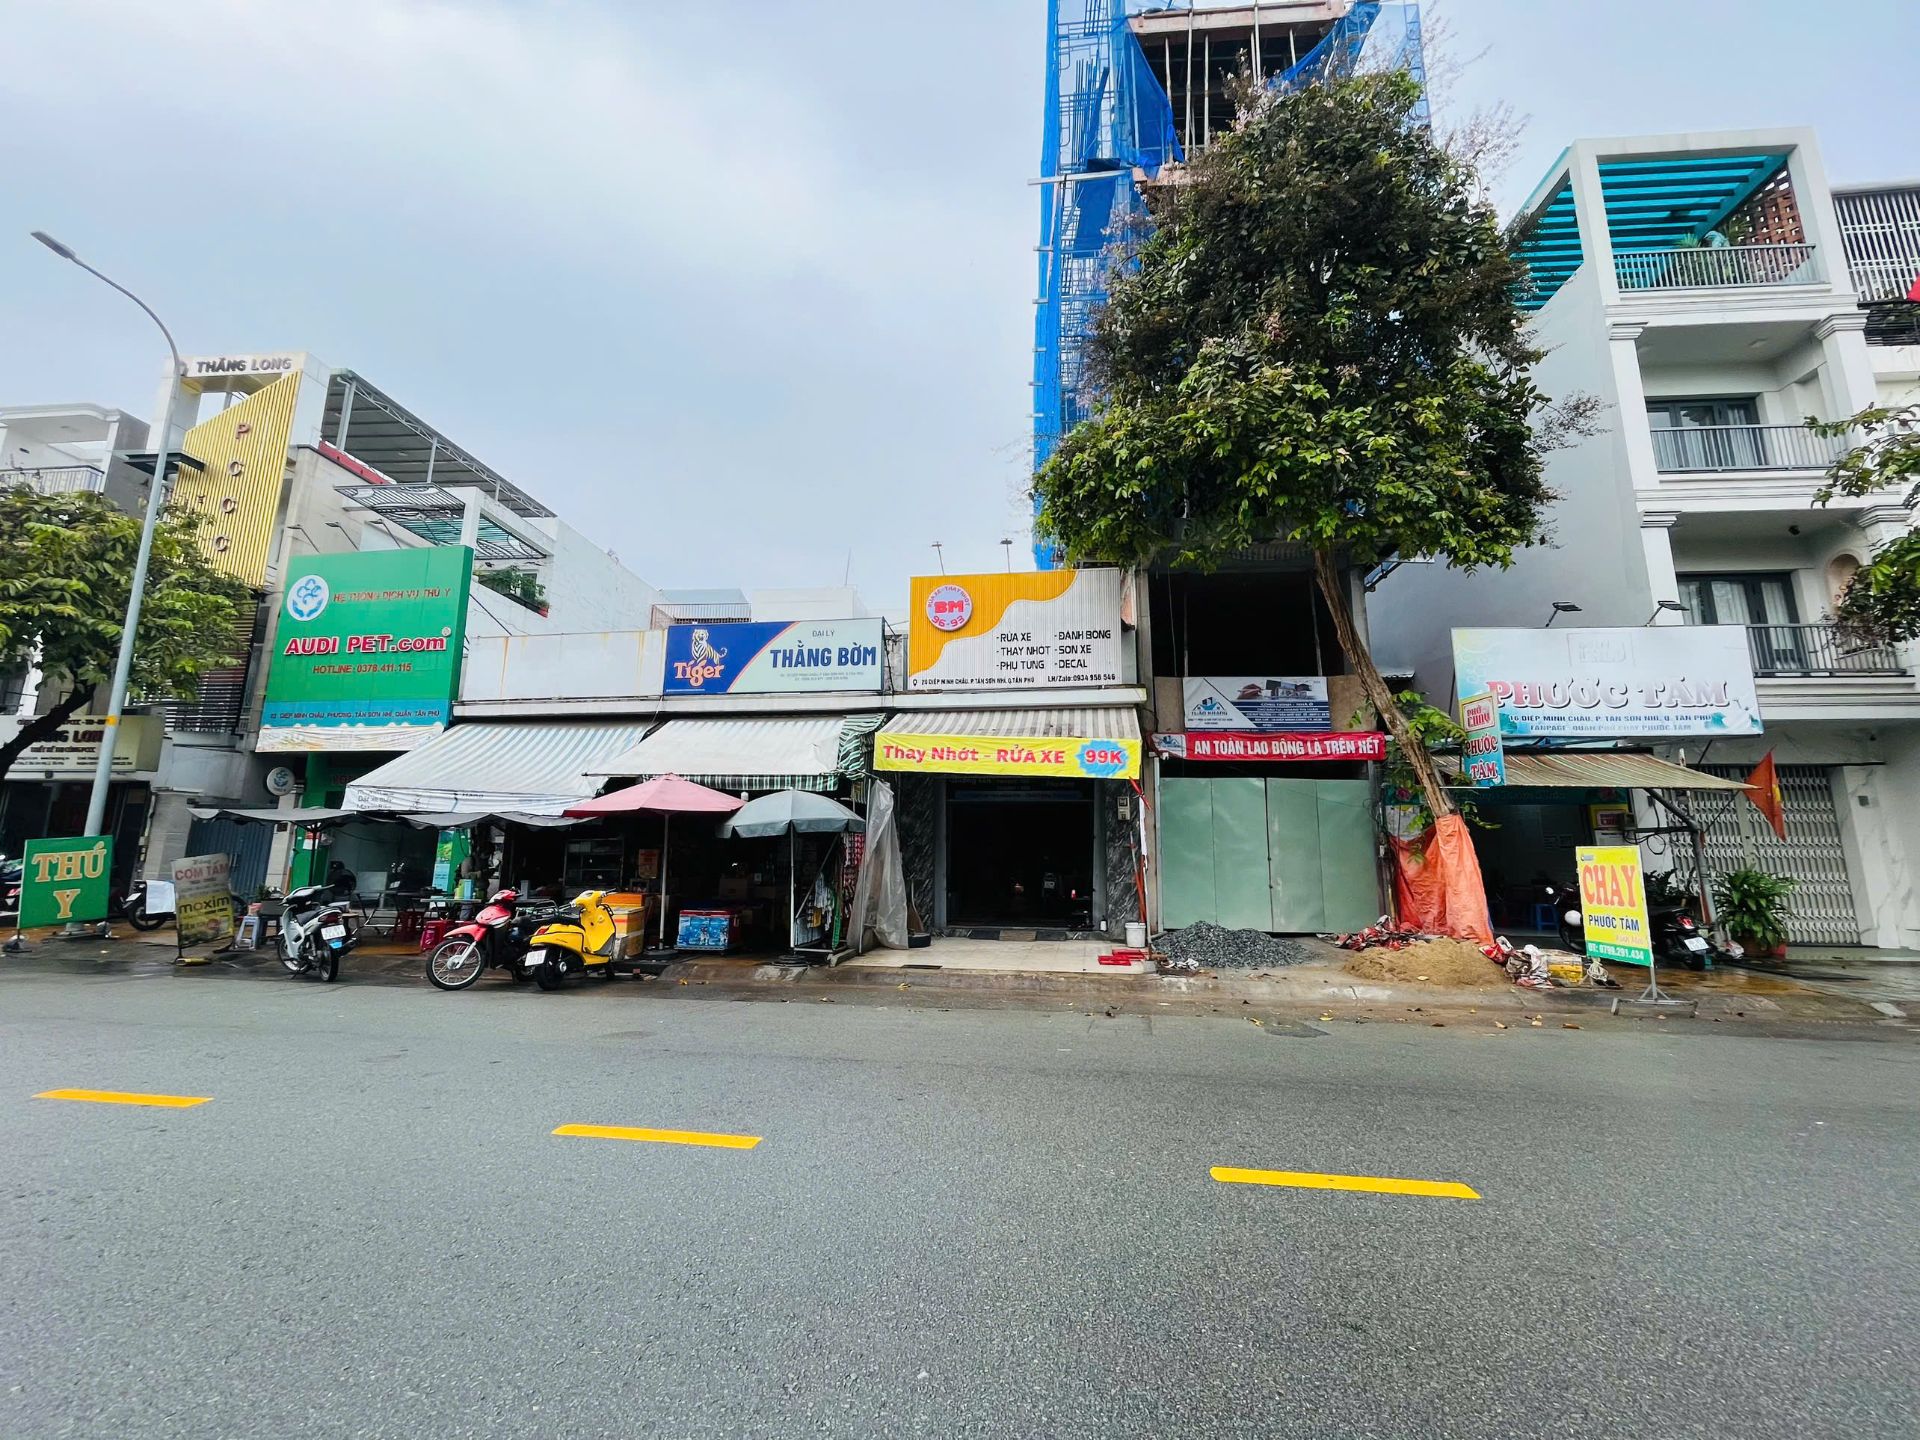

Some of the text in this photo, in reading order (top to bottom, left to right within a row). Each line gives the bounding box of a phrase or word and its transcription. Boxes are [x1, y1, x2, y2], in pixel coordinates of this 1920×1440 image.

[197, 357, 293, 373] THĂNG LONG
[934, 600, 964, 613] BM
[285, 634, 446, 655] AUDI PET.com
[1020, 632, 1032, 642] XE
[770, 639, 877, 668] THẰNG BỜM
[1080, 644, 1092, 654] XE
[673, 658, 725, 687] Tiger
[882, 743, 1123, 765] Thay Nhớt RỬA XE 99K
[1194, 736, 1380, 758] AN TOÀN LAO ĐỘNG LÀ TRÊN HẾT
[1470, 759, 1498, 780] TÂM
[31, 841, 108, 883] THÚ
[1582, 864, 1636, 908] CHAY
[53, 888, 81, 919] Y
[179, 895, 230, 914] maxim
